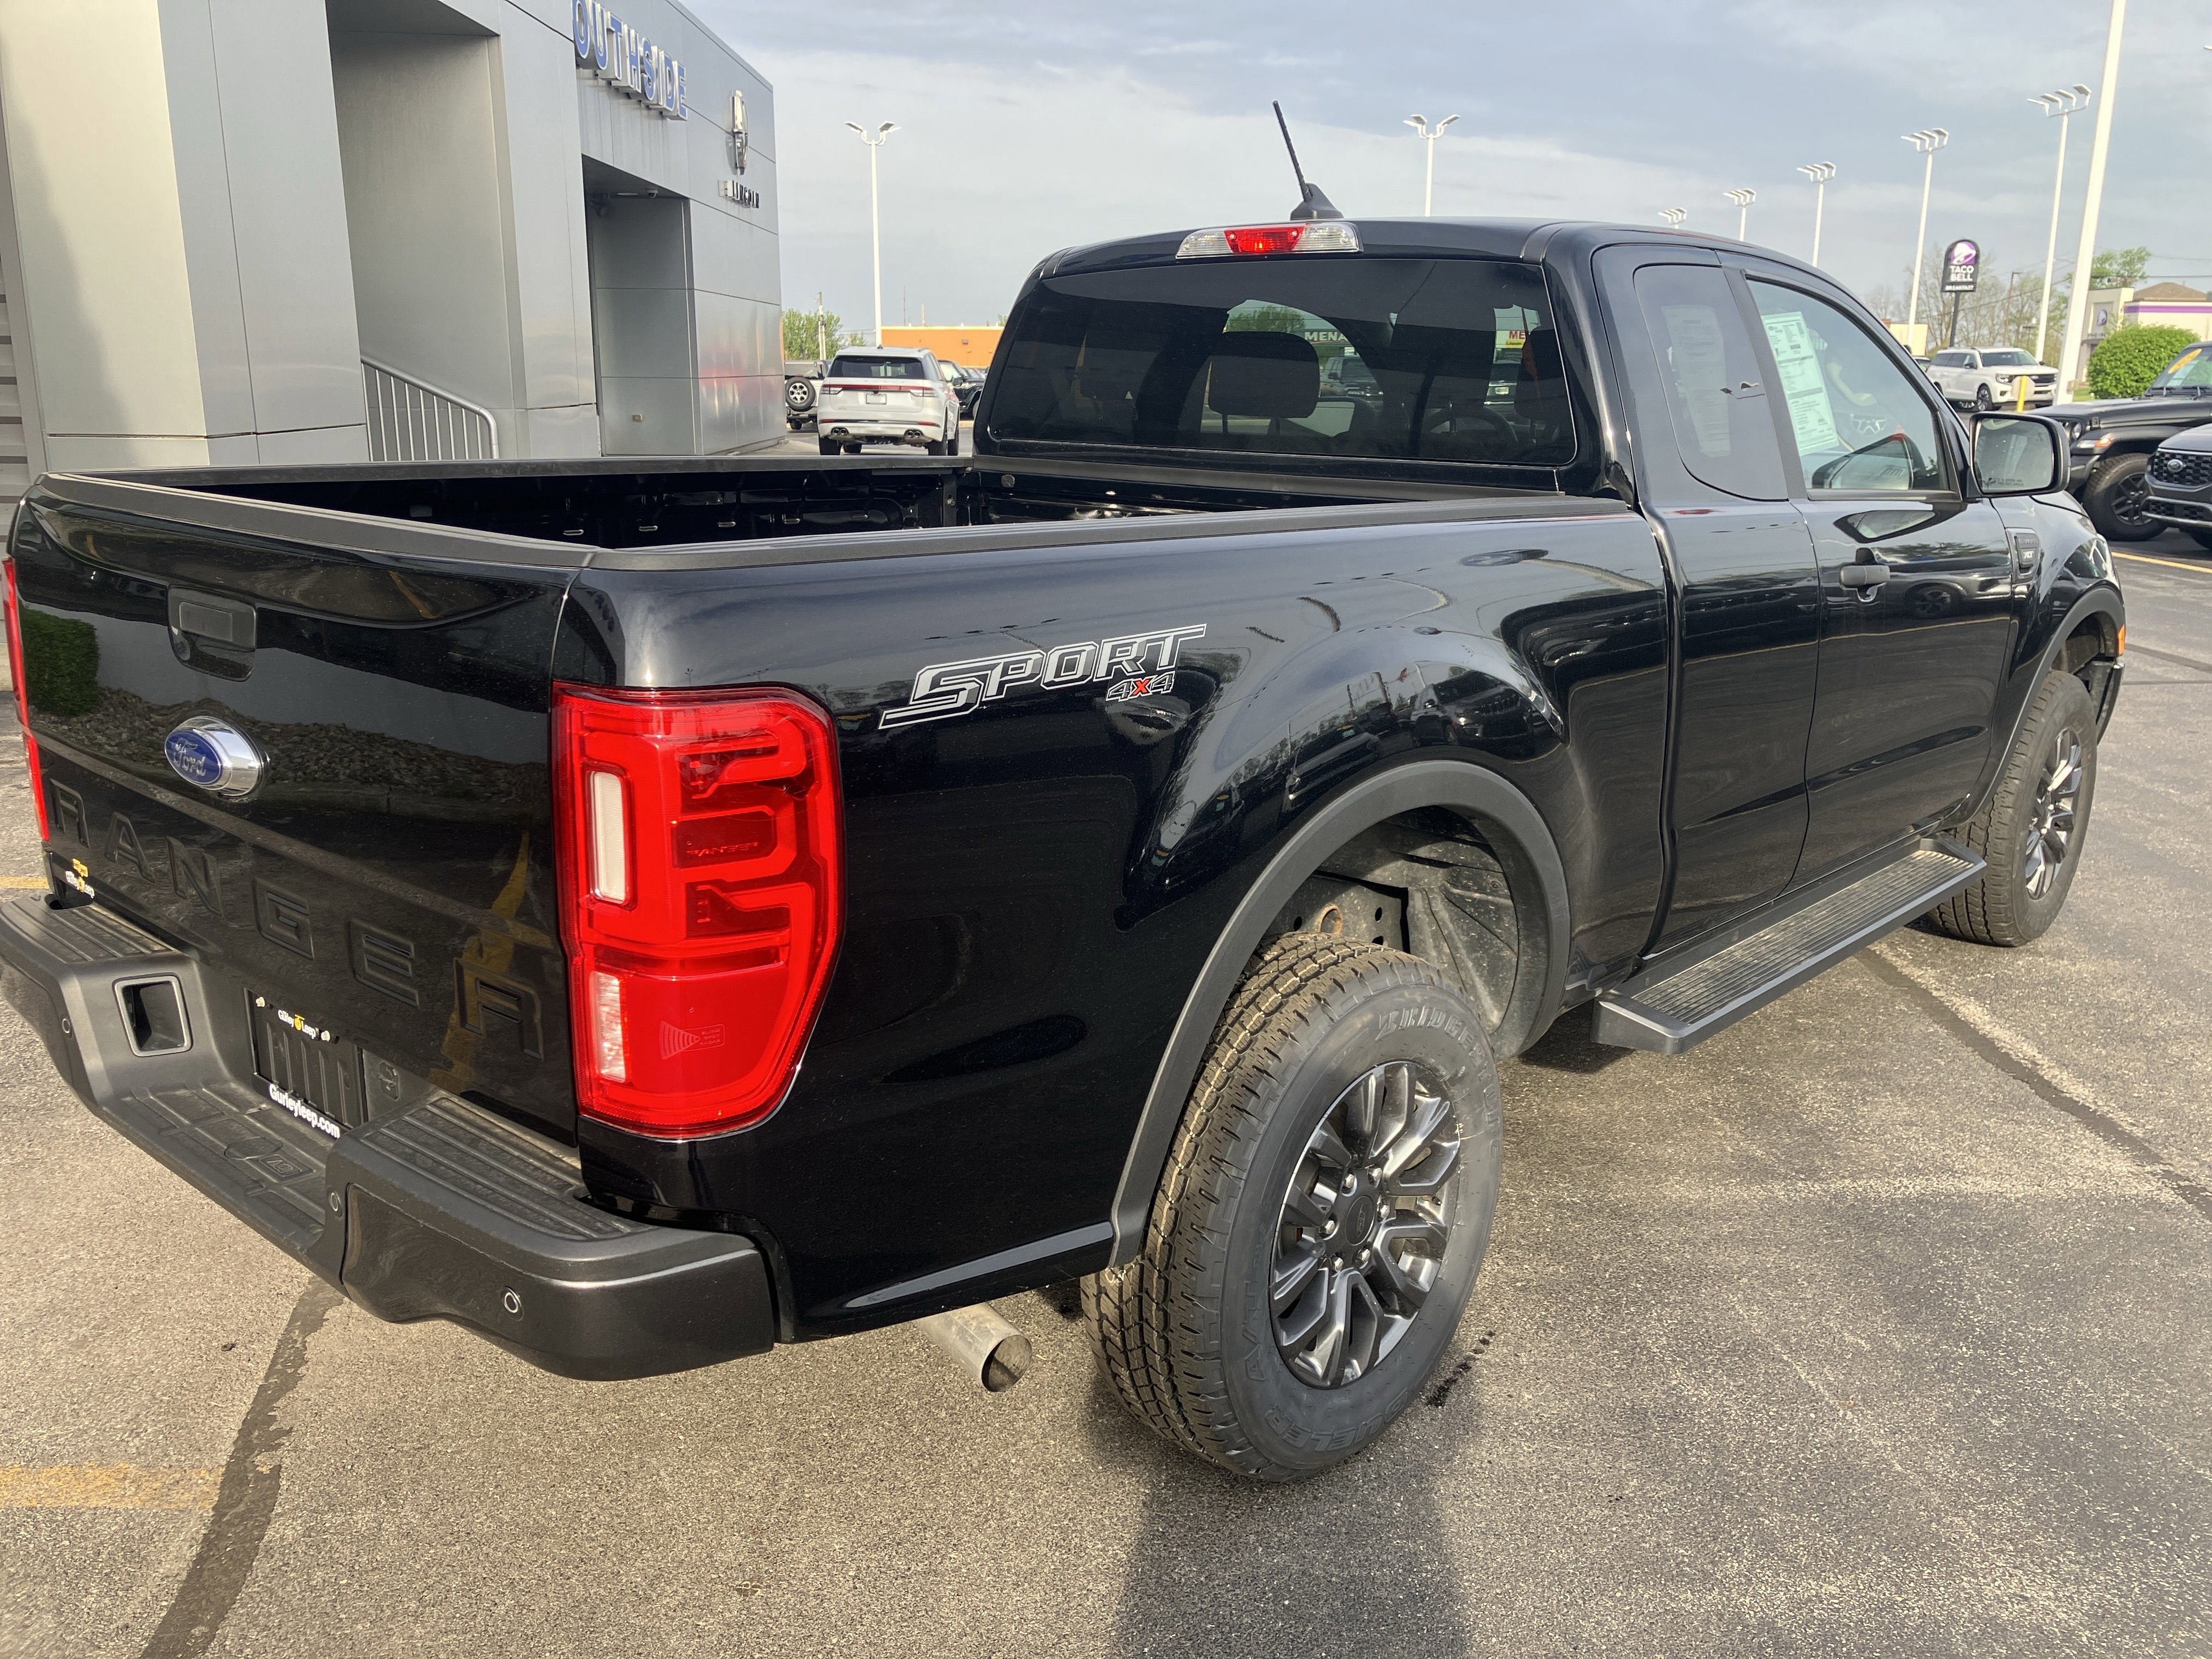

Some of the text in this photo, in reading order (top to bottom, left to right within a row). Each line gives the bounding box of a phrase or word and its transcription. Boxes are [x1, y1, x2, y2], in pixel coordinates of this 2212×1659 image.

[731, 179, 759, 208] LINCOLN
[1949, 265, 1974, 273] TACO
[1950, 273, 1973, 281] BELL
[878, 623, 1207, 730] SPORT
[172, 737, 207, 777] Ford
[49, 777, 545, 1062] RANGER
